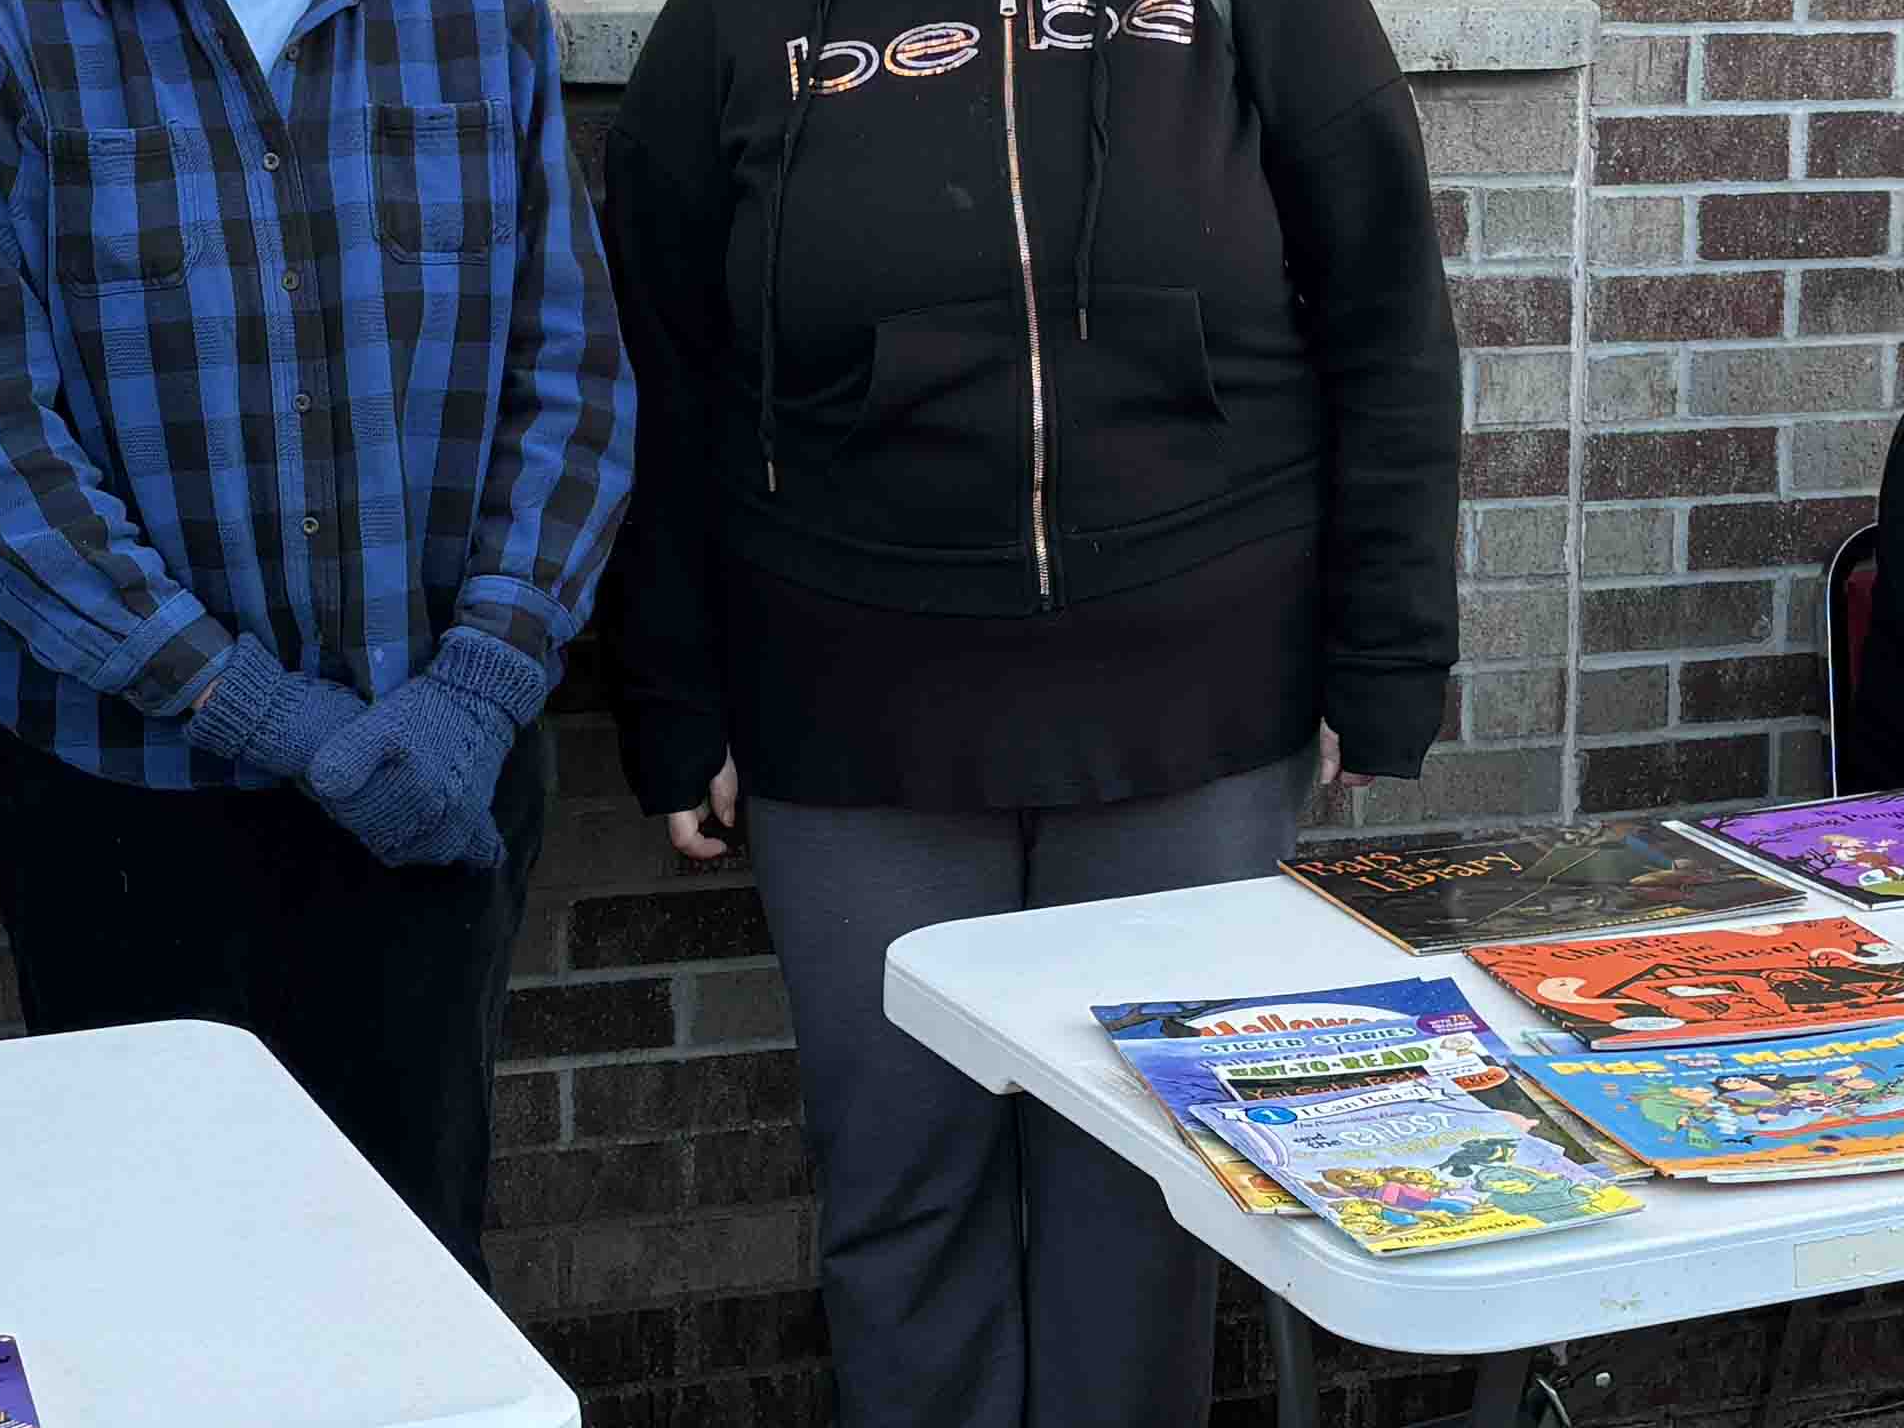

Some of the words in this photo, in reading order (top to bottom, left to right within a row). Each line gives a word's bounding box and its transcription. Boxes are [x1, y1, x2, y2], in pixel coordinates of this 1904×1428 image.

[1296, 850, 1404, 878] Bats
[1358, 850, 1524, 894] Library
[1550, 936, 1676, 963] Ghosts
[1199, 1035, 1308, 1054] STICKER
[1313, 1025, 1419, 1046] STORIES
[1313, 1098, 1359, 1117] Can
